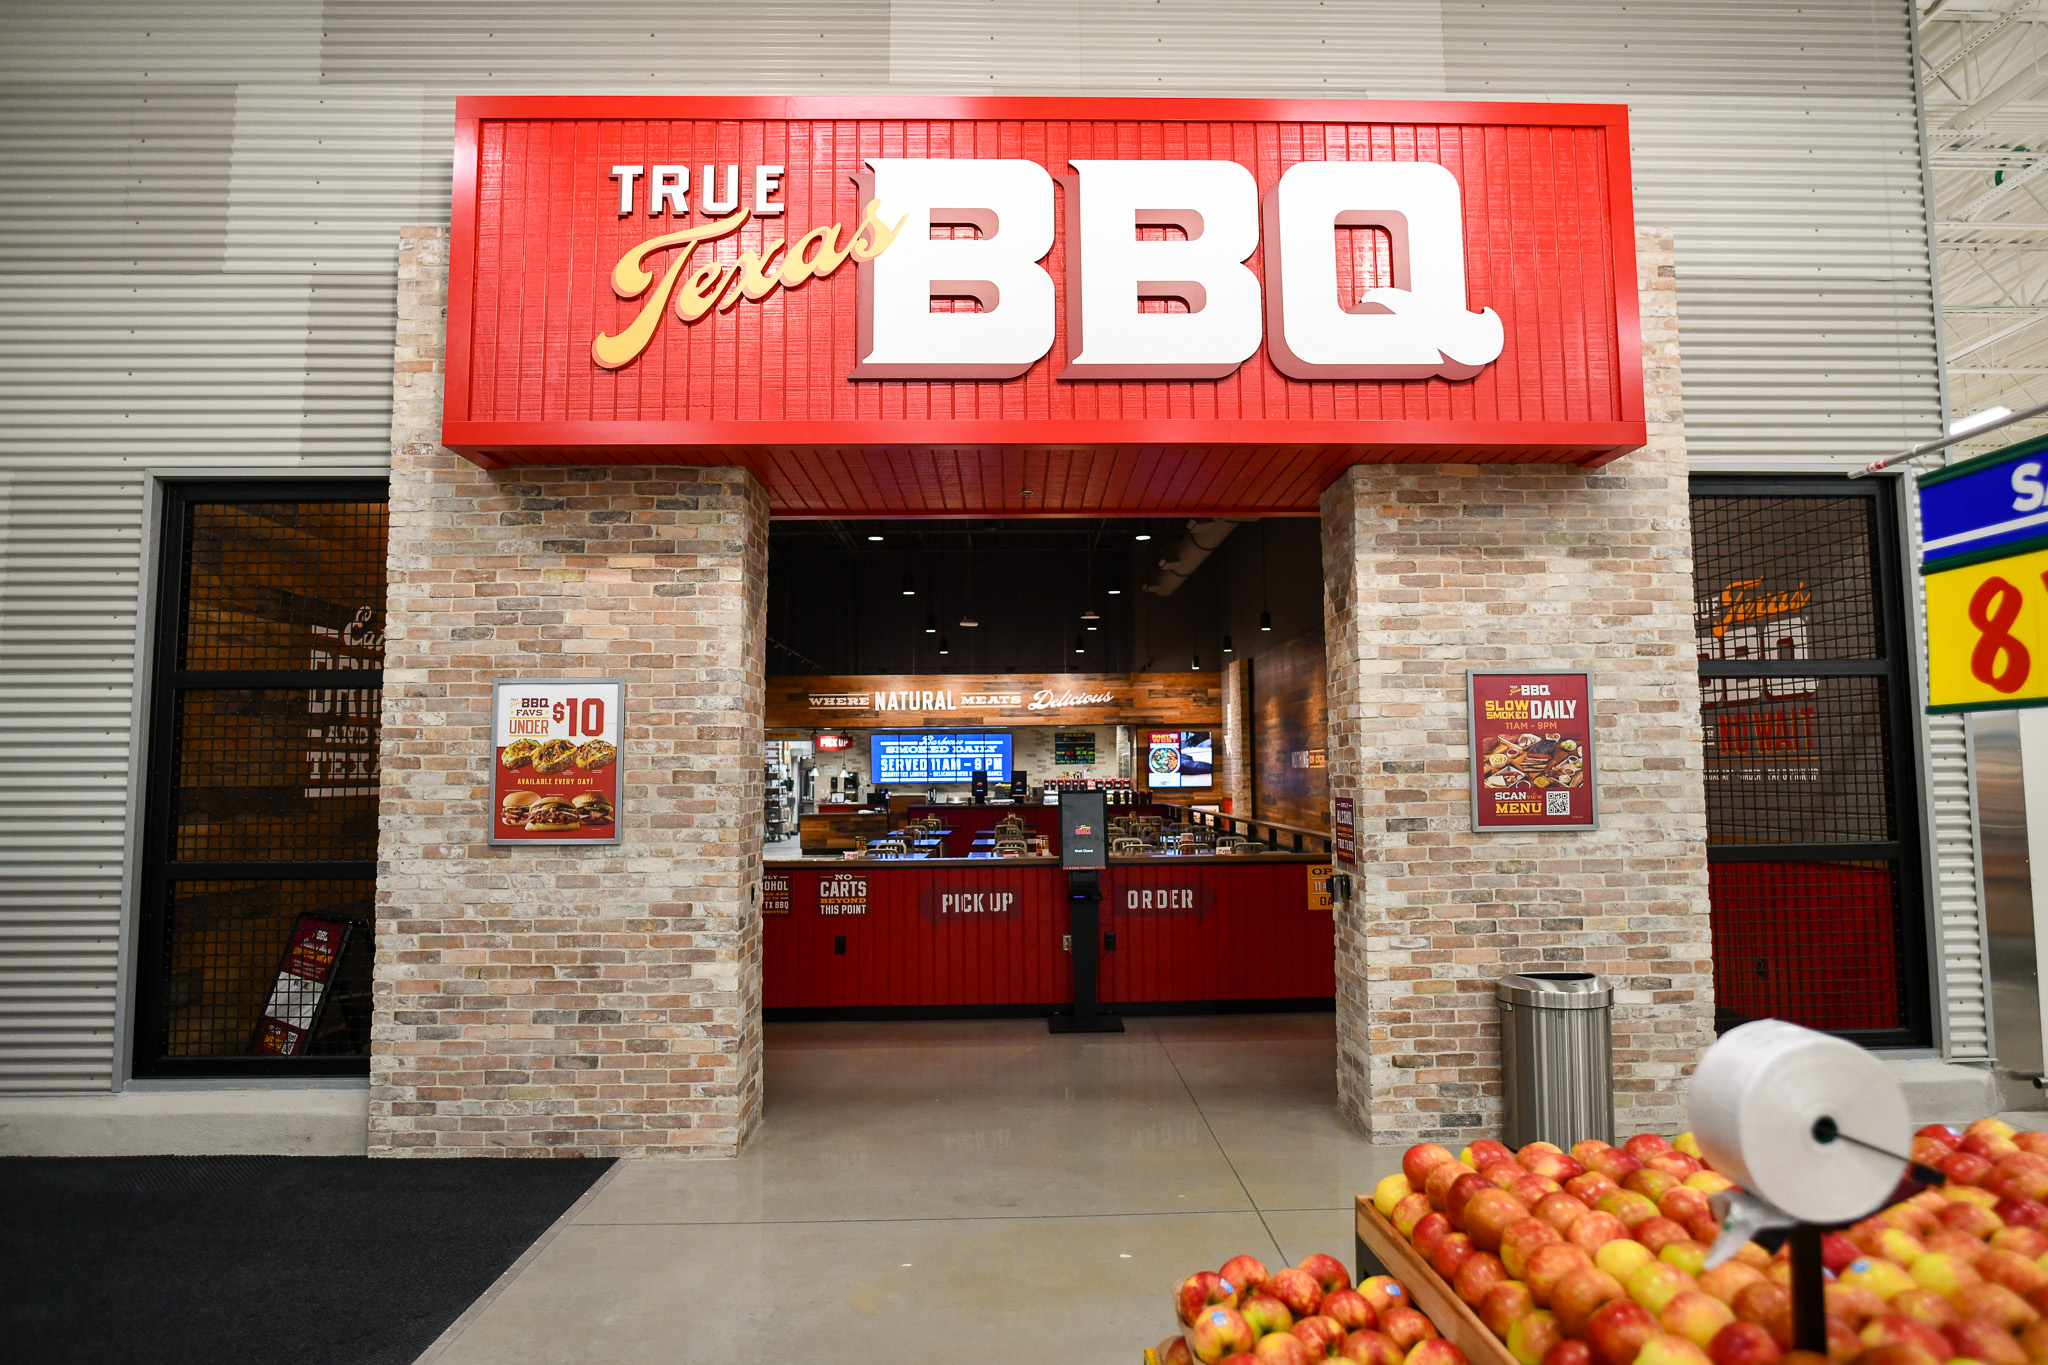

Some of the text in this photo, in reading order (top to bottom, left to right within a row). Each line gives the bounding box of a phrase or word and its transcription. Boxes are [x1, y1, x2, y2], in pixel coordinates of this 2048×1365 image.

[609, 164, 785, 217] TRUE
[854, 158, 1505, 378] BBQ
[591, 198, 909, 369] Texas
[2011, 462, 2048, 512] S
[1713, 576, 1811, 638] Texas
[1520, 684, 1551, 696] BBQ
[521, 698, 550, 708] BBQ
[809, 689, 1114, 711] WHERE NATURAL MEATS Delicious
[1485, 700, 1529, 711] SLOW
[1486, 711, 1529, 719] SMOKED
[1530, 700, 1577, 719] DAILY
[552, 698, 605, 737] $10
[509, 719, 549, 734] UNDER
[1505, 722, 1528, 730] 11AM
[1537, 722, 1557, 730] 9PM
[1719, 707, 1815, 755] NO WAIT
[326, 726, 369, 745] AND
[820, 738, 849, 747] PICK UP
[885, 745, 998, 754] SMOKED DAILY
[881, 758, 928, 771] SERVED
[974, 758, 982, 770] 9
[985, 757, 1003, 770] PM
[577, 777, 594, 785] DAY!
[1495, 792, 1527, 800] SCAN
[1496, 802, 1543, 814] MENU
[764, 881, 789, 891] OHOL
[820, 881, 867, 897] CARTS
[765, 901, 789, 910] TX BBQ
[942, 892, 1013, 913] PICK UP
[1127, 889, 1194, 909] ORDER
[820, 904, 867, 914] THIS POINT
